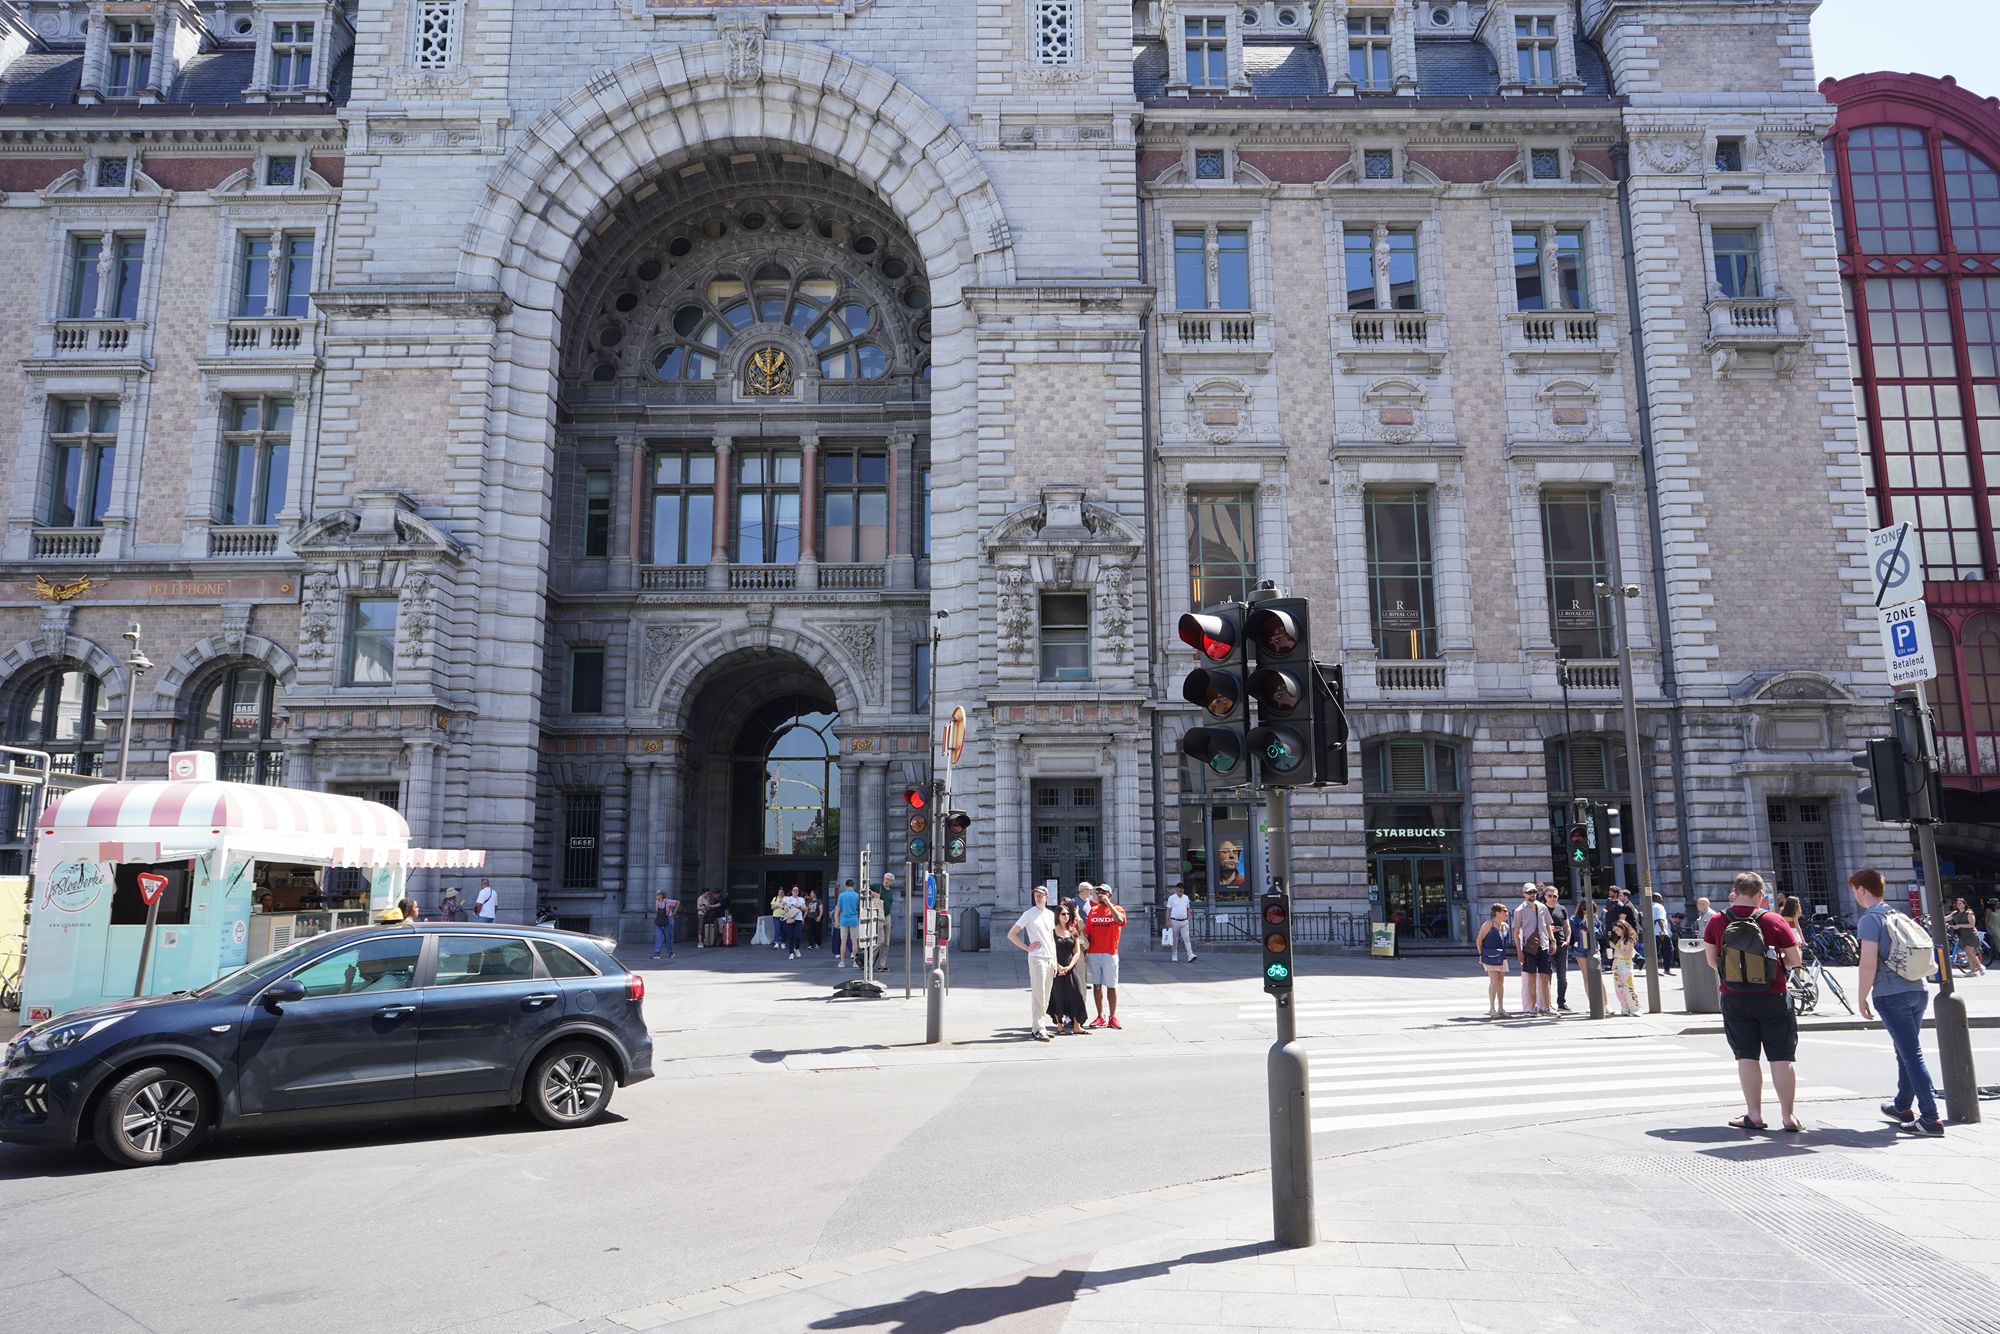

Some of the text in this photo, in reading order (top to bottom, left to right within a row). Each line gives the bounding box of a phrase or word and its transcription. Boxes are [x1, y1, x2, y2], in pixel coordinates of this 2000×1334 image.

[1873, 528, 1903, 547] ZONE
[148, 583, 225, 596] TELEPHONE
[1396, 600, 1404, 610] R
[1571, 599, 1580, 609] R
[1885, 606, 1916, 624] ZONE
[1896, 624, 1911, 648] P
[1893, 655, 1925, 670] Betalend
[1893, 668, 1928, 681] Herhaling
[236, 705, 257, 713] BASE
[1375, 828, 1446, 837] STARBUCKS
